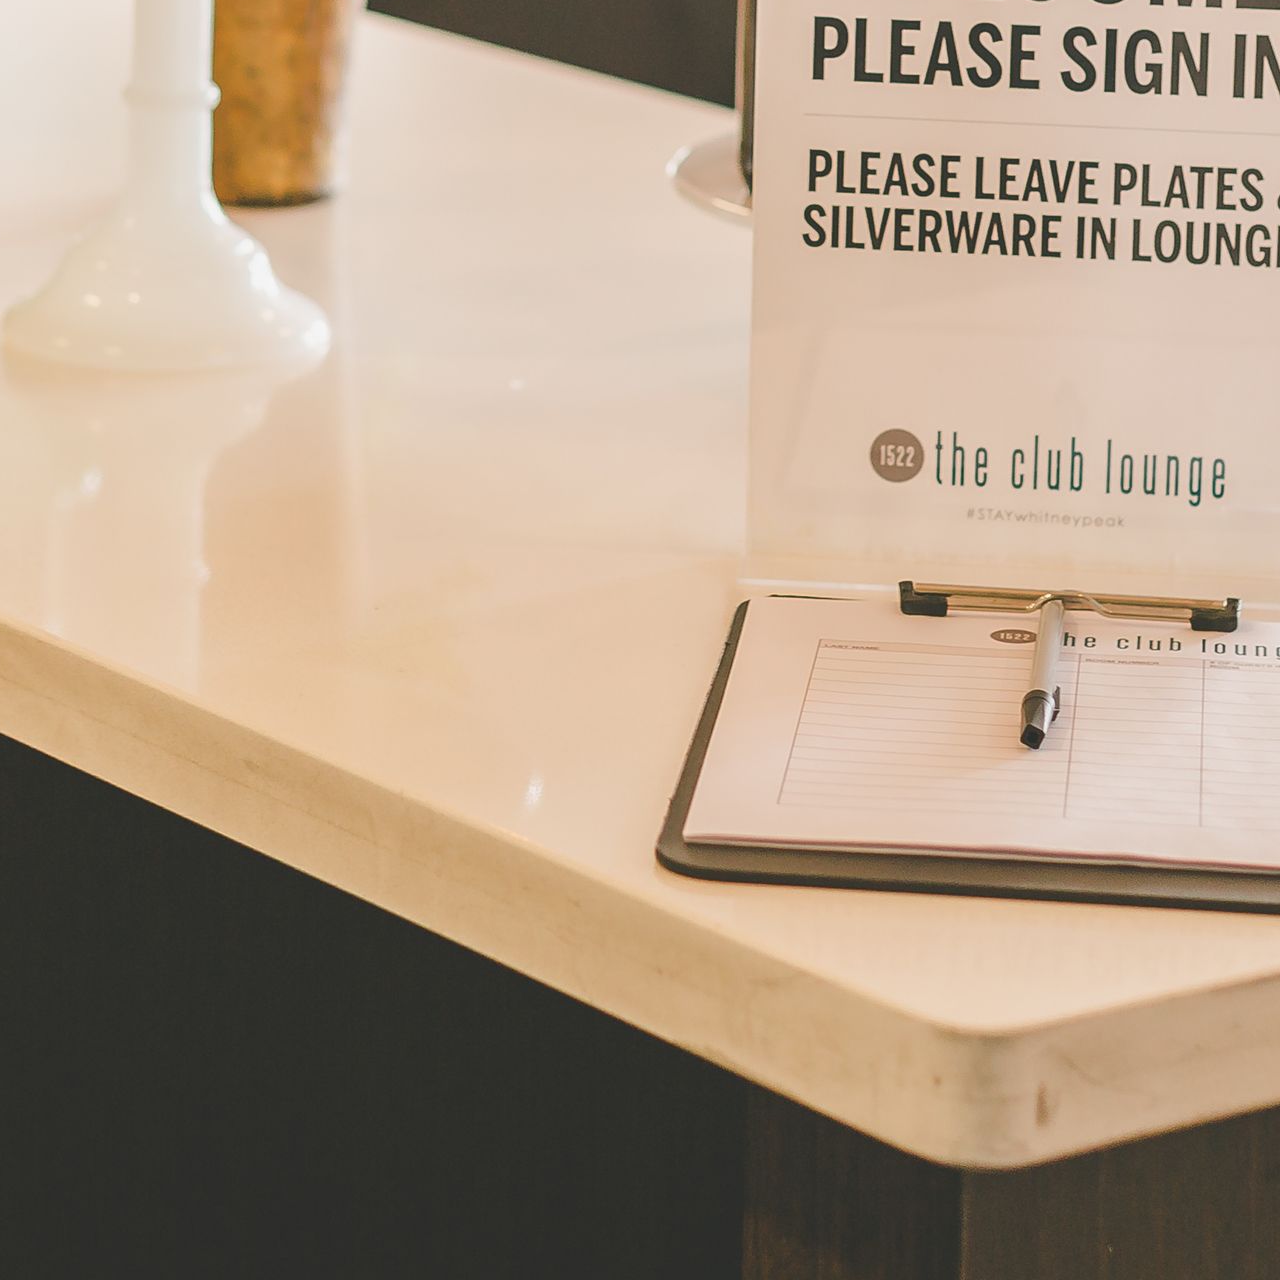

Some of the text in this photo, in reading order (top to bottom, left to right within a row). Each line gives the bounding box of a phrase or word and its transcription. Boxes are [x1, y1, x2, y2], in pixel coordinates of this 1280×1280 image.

[812, 16, 1041, 90] PLEASE
[1060, 26, 1210, 97] SIGN
[808, 148, 961, 200] PLEASE
[975, 155, 1099, 205] LEAVE
[1113, 163, 1264, 212] PLATES
[802, 204, 1062, 258] SILVERWARE
[1076, 216, 1116, 260] IN
[879, 431, 1226, 507] 1522 the club lounge
[999, 632, 1031, 641] 1522
[1063, 632, 1097, 649] he
[1116, 635, 1182, 652] club
